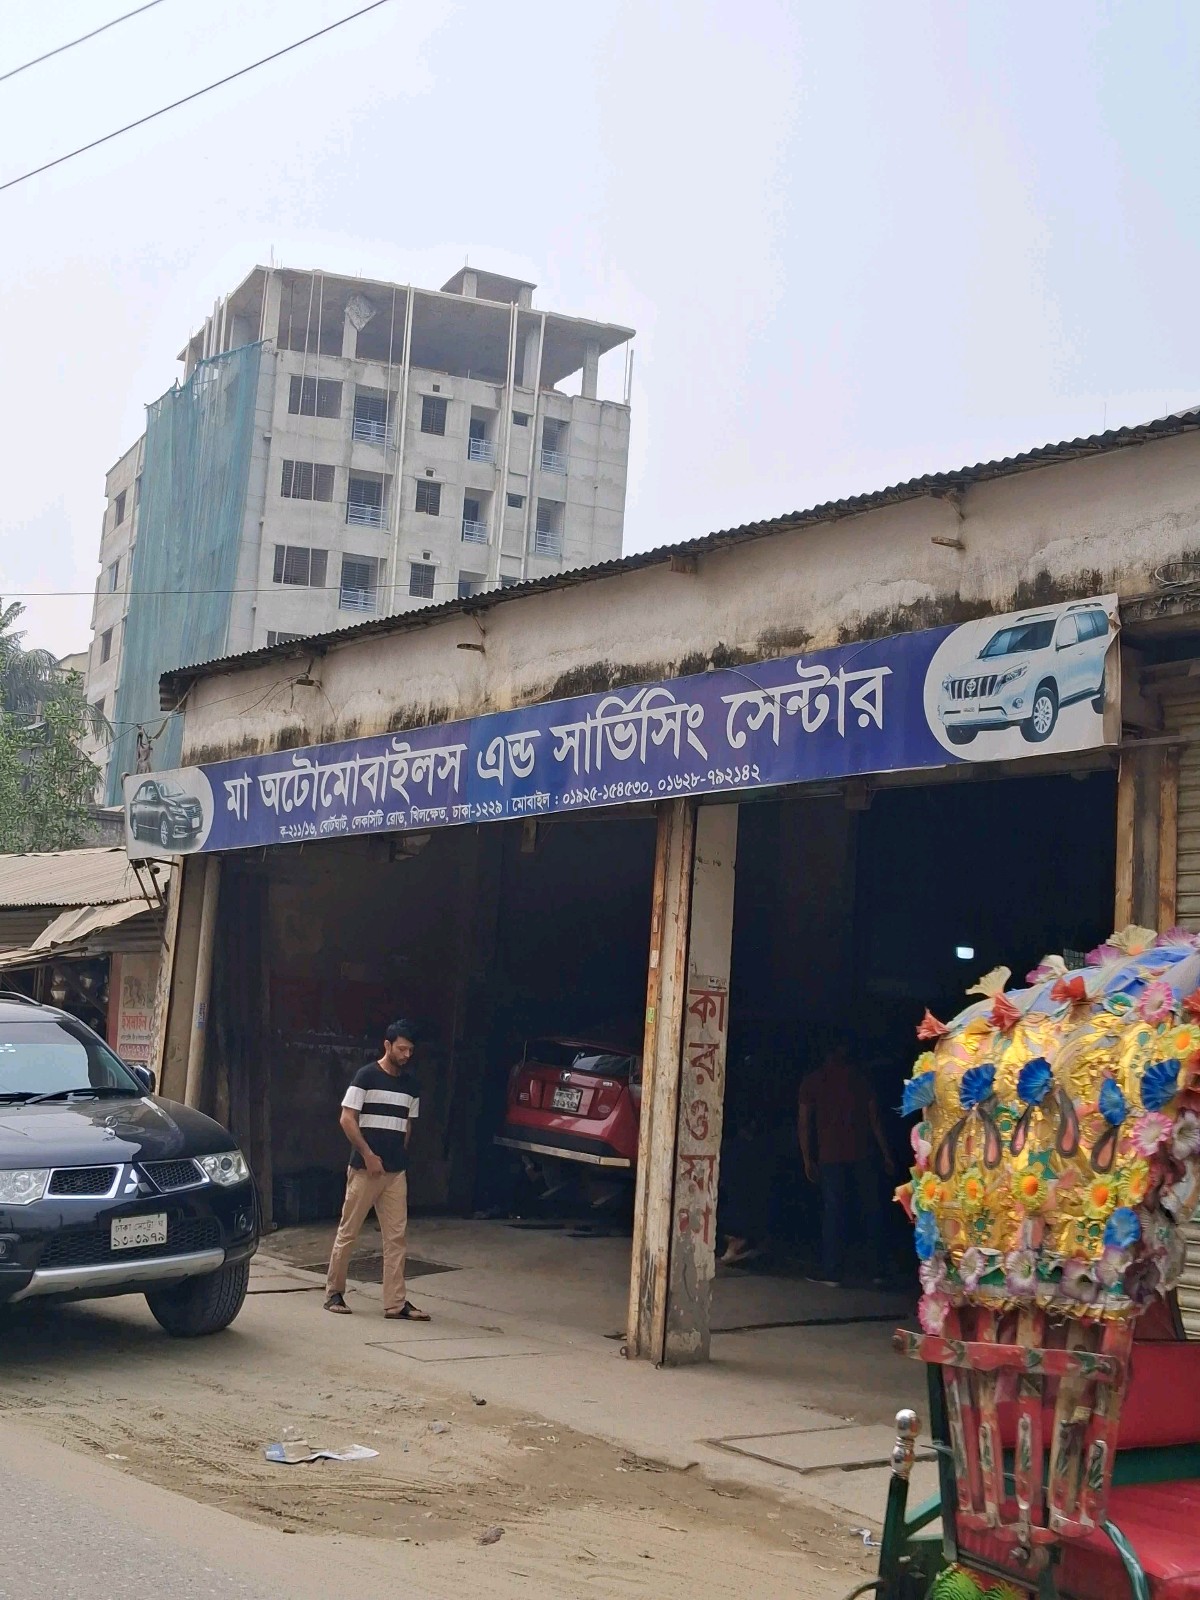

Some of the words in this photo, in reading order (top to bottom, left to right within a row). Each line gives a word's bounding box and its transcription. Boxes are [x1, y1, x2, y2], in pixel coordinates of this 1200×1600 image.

[223, 771, 253, 821] মা
[257, 737, 468, 815] অটোমোবাইলস
[476, 729, 541, 787] এন্ড
[549, 687, 708, 776] সার্ভিসিং
[720, 659, 894, 748] সেন্টার
[351, 808, 385, 830] লেকসিটি
[386, 810, 407, 828] রোড,
[410, 805, 449, 824] খিলক্ষেত,
[452, 800, 503, 820] ঢাকা-১২২৯
[511, 789, 551, 813] মোবাইল
[657, 764, 762, 792] ০১৬২৮-৭৯২১৪২
